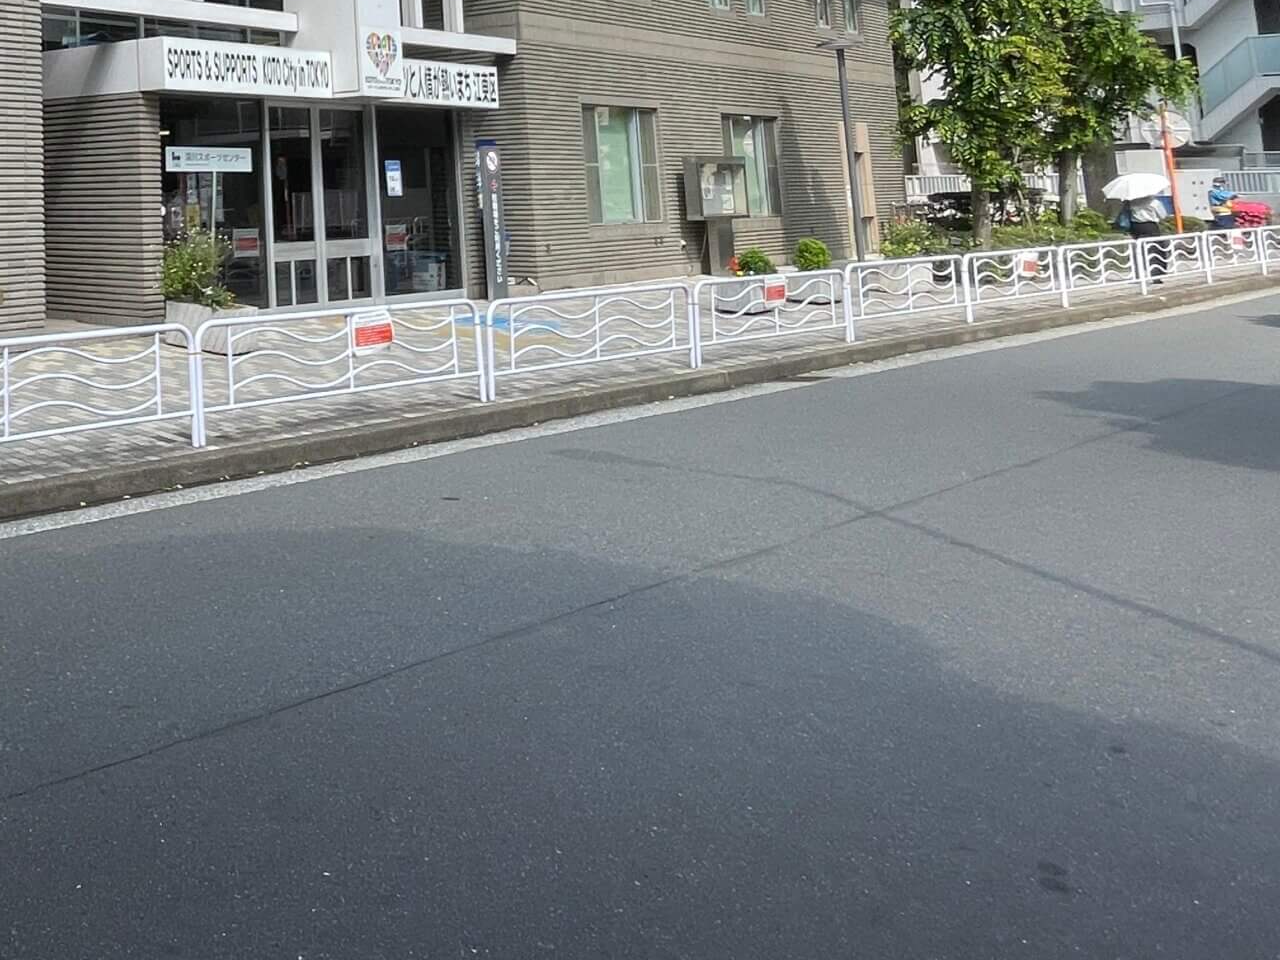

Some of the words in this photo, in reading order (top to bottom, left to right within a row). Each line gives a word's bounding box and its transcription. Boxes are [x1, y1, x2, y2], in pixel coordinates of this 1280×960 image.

[168, 48, 203, 80] SPORTS
[205, 51, 212, 80] &
[214, 52, 258, 84] SUPPORTS
[262, 56, 281, 85] KOTO
[282, 57, 297, 93] City
[298, 58, 306, 88] in
[306, 59, 329, 89] TOKYO
